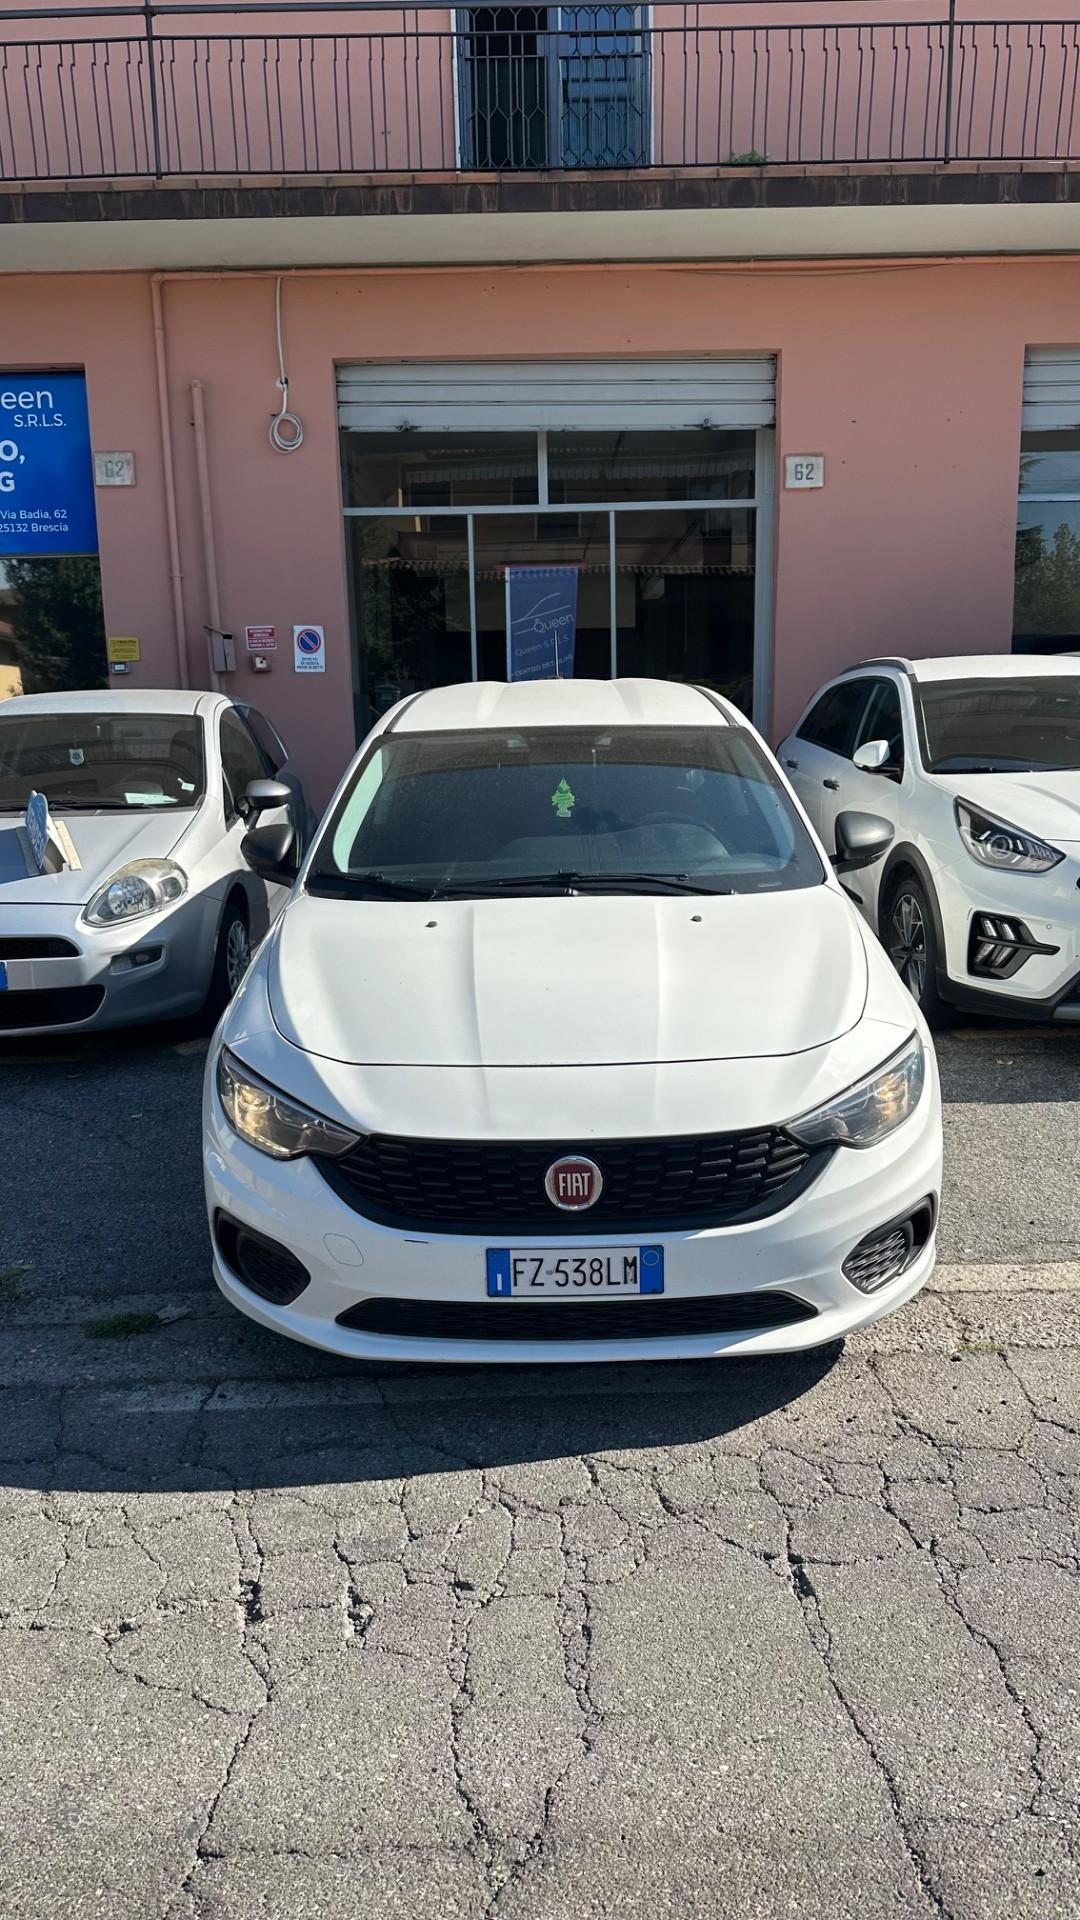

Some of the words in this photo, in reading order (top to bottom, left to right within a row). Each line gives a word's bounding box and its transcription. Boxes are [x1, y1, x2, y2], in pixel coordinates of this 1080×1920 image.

[13, 413, 67, 428] S.R.L.S.
[794, 463, 815, 481] 62
[0, 509, 17, 520] Via
[19, 508, 52, 520] Badia,
[54, 508, 68, 519] 62
[31, 522, 69, 533] Brescia
[533, 614, 573, 633] Queen
[558, 1172, 592, 1197] FIAT
